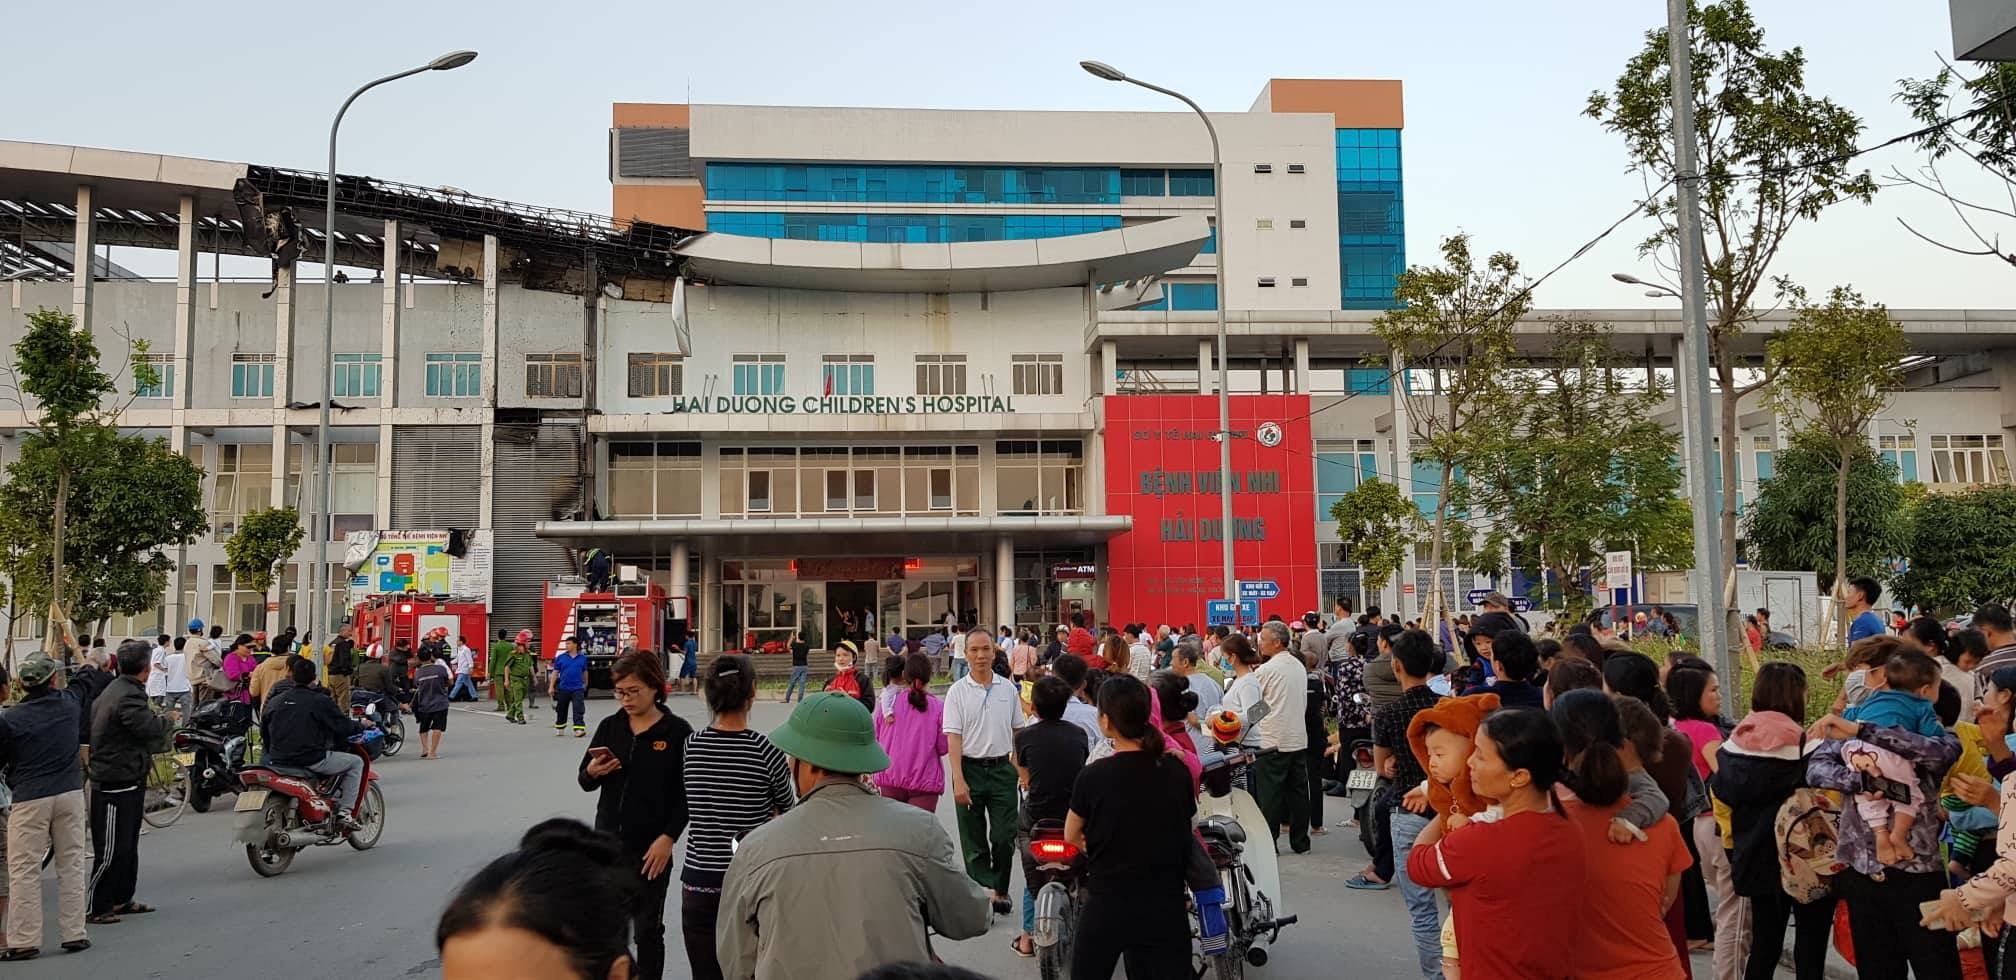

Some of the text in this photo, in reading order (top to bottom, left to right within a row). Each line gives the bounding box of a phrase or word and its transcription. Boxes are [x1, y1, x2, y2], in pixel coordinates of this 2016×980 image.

[672, 395, 1015, 414] HAI DUONG CHILDREN'S HOSPITAL
[1140, 467, 1192, 500] BỆNH
[1247, 471, 1280, 494] NHI
[1161, 510, 1193, 542] HẢI
[1078, 565, 1095, 573] ATM
